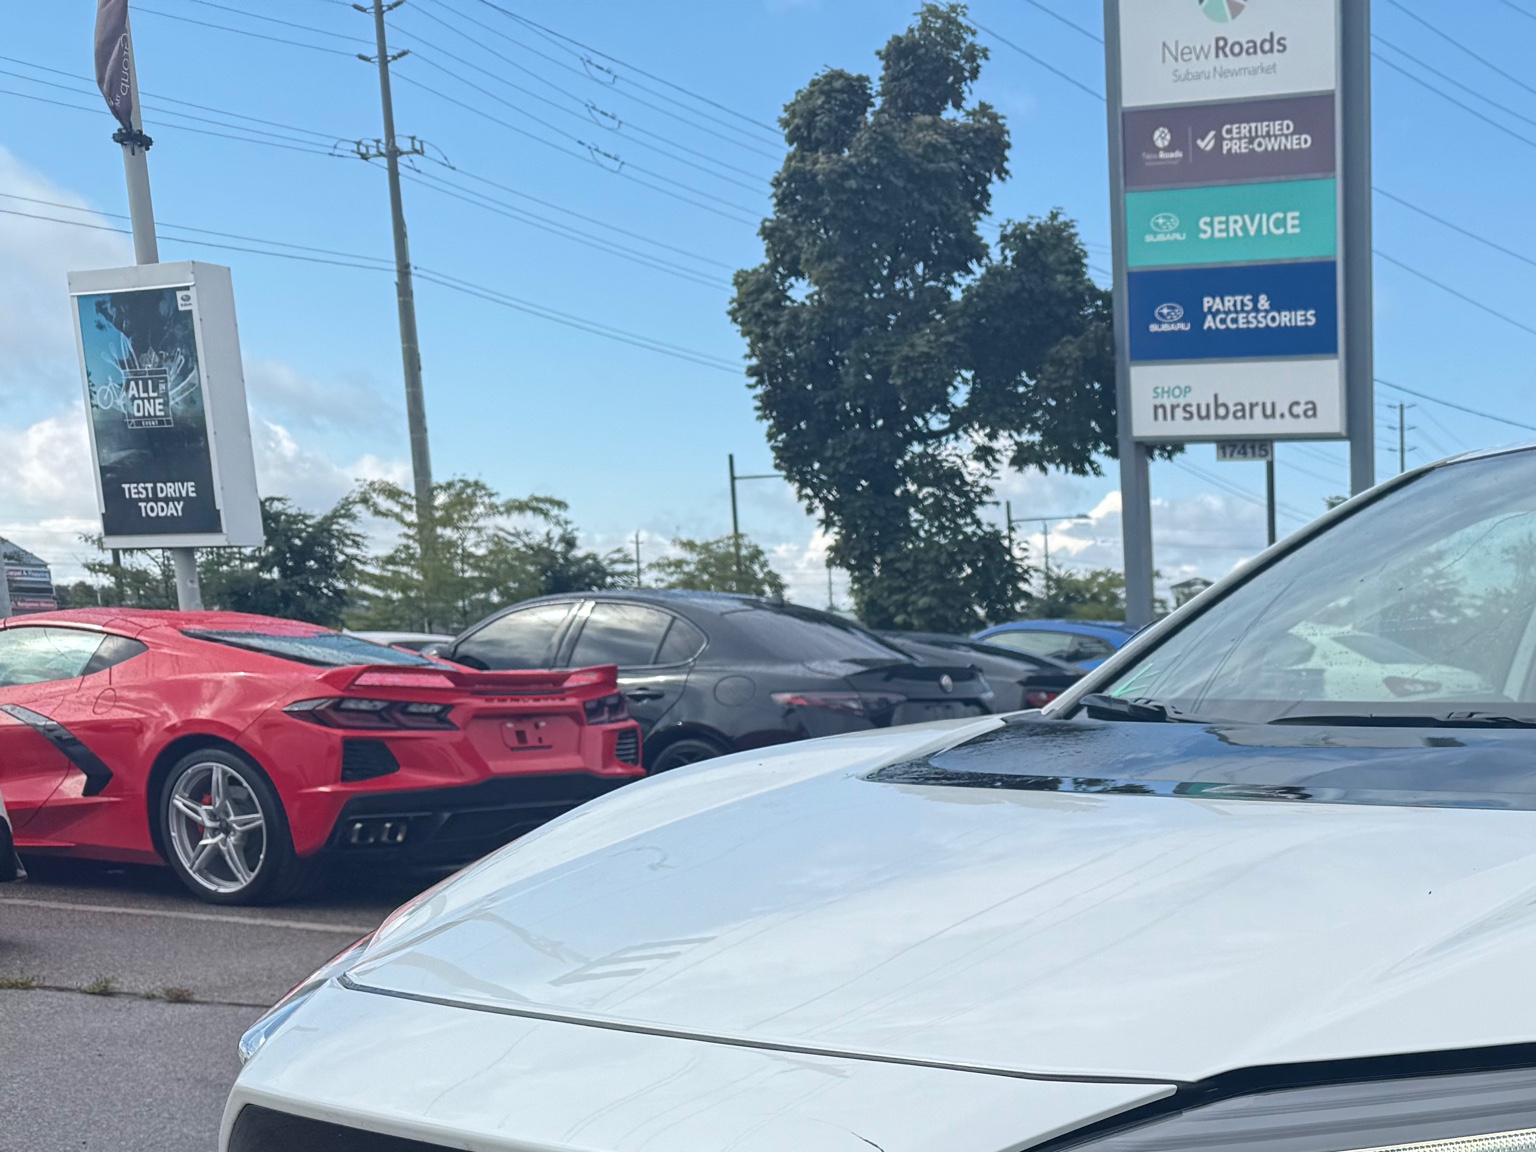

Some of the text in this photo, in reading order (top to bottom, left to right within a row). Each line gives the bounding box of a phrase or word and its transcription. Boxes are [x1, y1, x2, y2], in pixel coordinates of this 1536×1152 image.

[1172, 62, 1277, 83] Subaru Newmarket
[1221, 119, 1294, 139] CERTIFIED
[1222, 134, 1312, 155] PRE-OWNED
[1198, 211, 1301, 239] SERVICE
[1144, 232, 1187, 242] SUBARU
[1202, 294, 1271, 312] PARTS &
[1148, 322, 1191, 332] SUBARU
[1202, 310, 1317, 330] ACCESSORIES
[128, 379, 158, 399] ALL
[1152, 385, 1192, 399] SHOP
[133, 398, 165, 417] ONE
[1152, 393, 1318, 422] nrsubaru.ca
[1220, 443, 1270, 458] 17415
[121, 481, 197, 499] TEST DRIVE
[138, 501, 184, 518] TODAY
